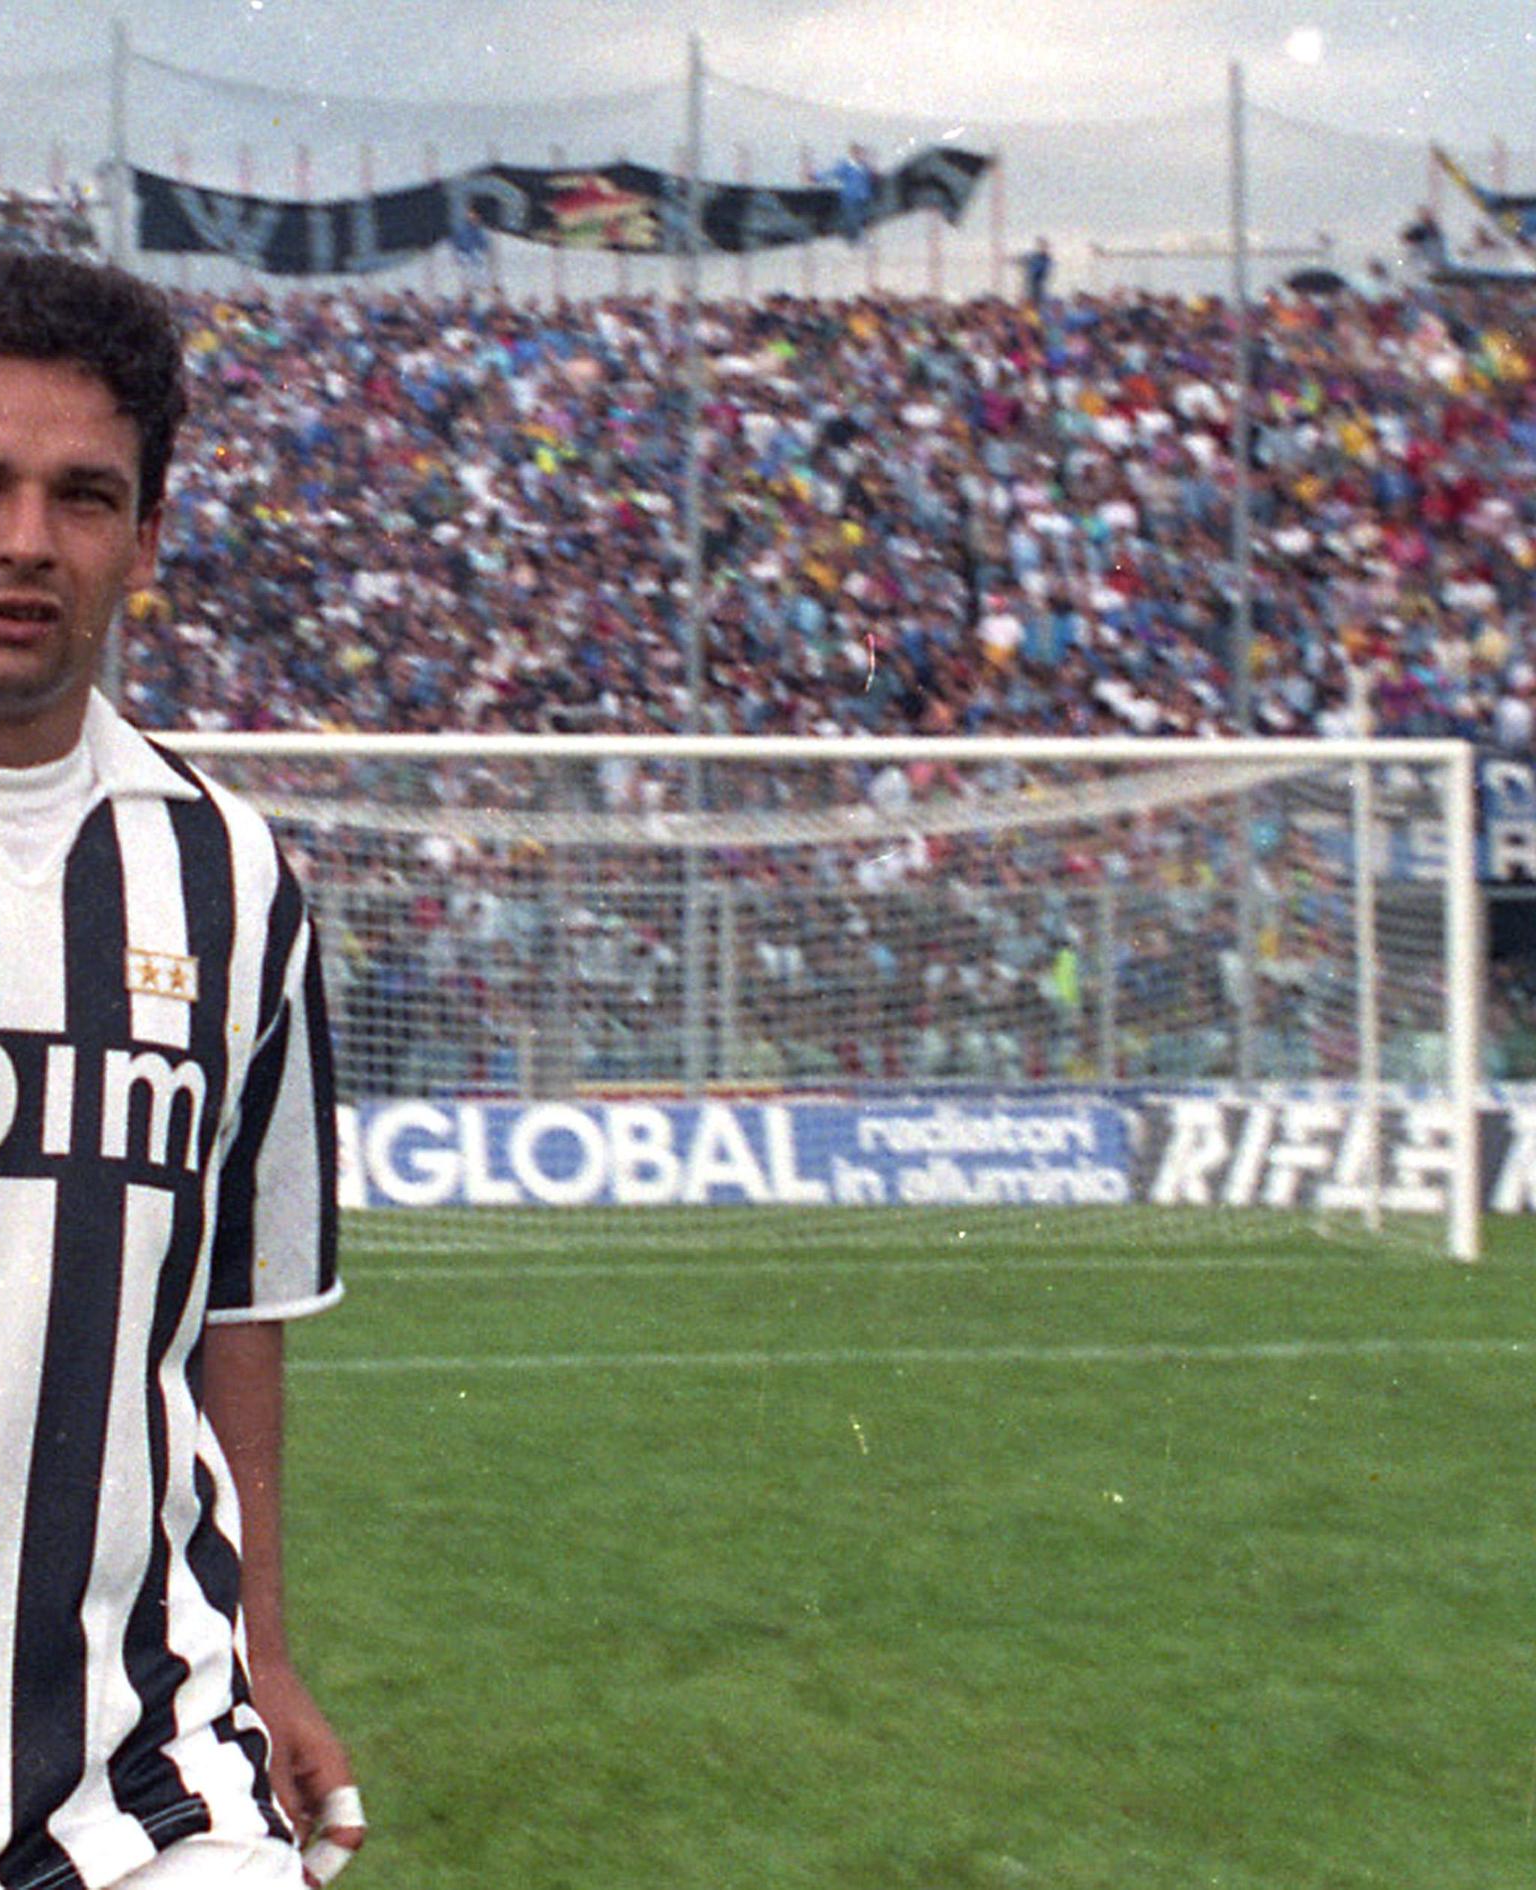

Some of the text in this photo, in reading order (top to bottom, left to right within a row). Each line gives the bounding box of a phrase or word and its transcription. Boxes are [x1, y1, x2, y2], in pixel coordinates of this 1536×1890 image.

[367, 1102, 828, 1207] GLOBAL
[858, 1101, 1096, 1153] radiatori
[1149, 1102, 1464, 1213] RIFLE
[832, 1156, 1130, 1206] in alluminio
